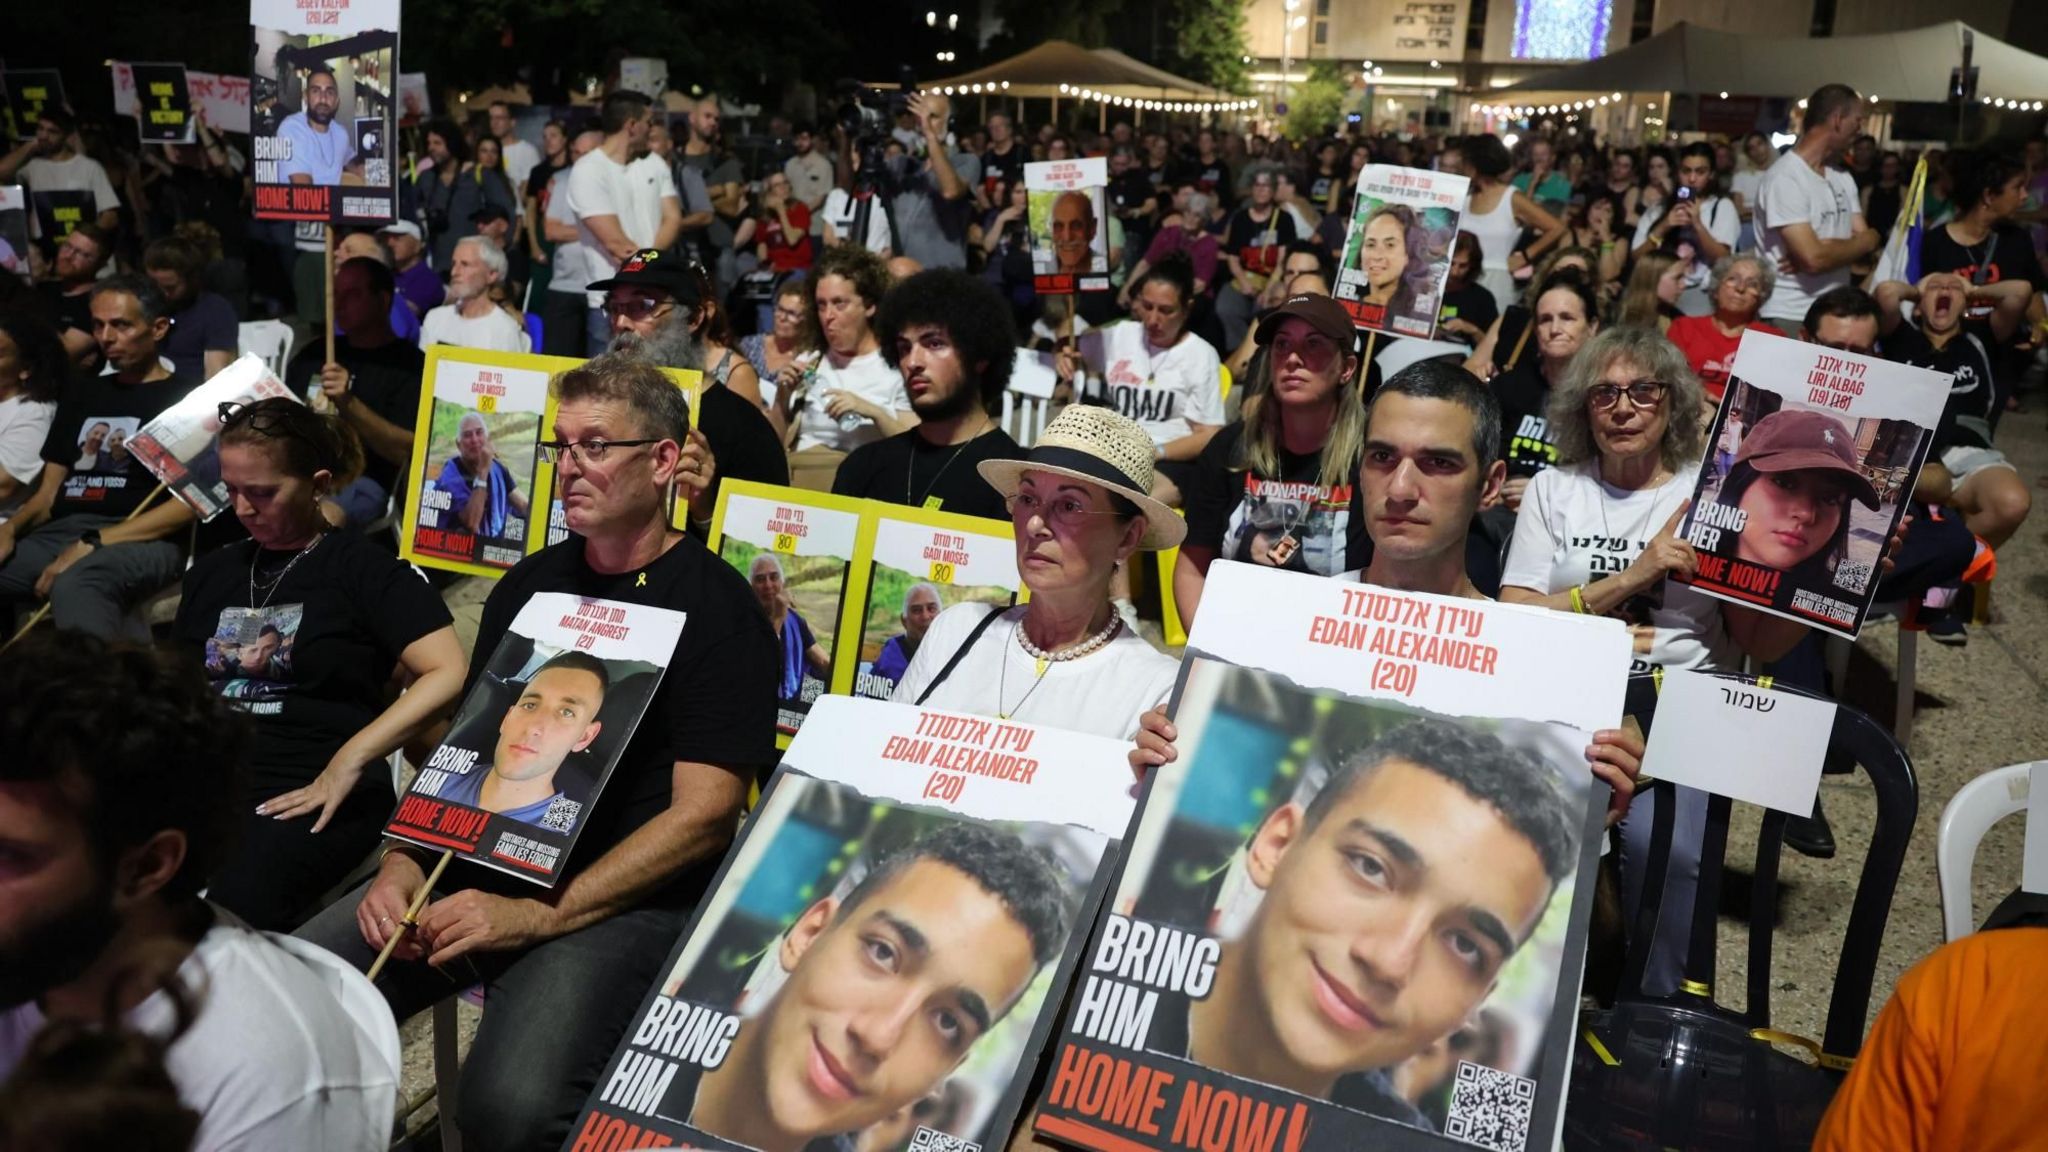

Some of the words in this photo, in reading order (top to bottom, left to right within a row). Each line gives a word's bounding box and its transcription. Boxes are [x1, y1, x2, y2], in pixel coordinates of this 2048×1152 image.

[254, 136, 293, 160] BRING
[255, 160, 278, 184] HIM
[256, 187, 290, 209] HOME
[293, 187, 330, 212] NOW!
[1807, 370, 1828, 388] LIRI
[1828, 375, 1865, 396] ALBAG
[1845, 361, 1867, 379] לירי
[481, 396, 495, 411] 80
[1808, 387, 1829, 408] (19)
[422, 489, 452, 511] BRING
[419, 507, 439, 528] HIM
[767, 519, 785, 533] GADI
[784, 522, 808, 538] MOSES
[1692, 498, 1748, 533] BRING
[416, 527, 444, 549] HOME
[445, 533, 475, 555] NOW!
[777, 534, 793, 549] 80
[1686, 523, 1721, 552] HER
[923, 546, 942, 560] GADI
[942, 549, 969, 566] MOSES
[934, 563, 951, 582] 80
[1695, 552, 1728, 581] OME
[1727, 562, 1782, 597] NOW!
[1342, 589, 1432, 629] אלכסנדר
[1791, 595, 1828, 616] FAMILIES
[1826, 606, 1856, 626] FORUM
[1794, 588, 1823, 603] HOSTAGES
[1822, 597, 1835, 607] AND
[1833, 600, 1859, 615] MISSING
[559, 615, 591, 632] MATAN
[588, 621, 631, 641] ANGREST
[1435, 605, 1484, 638] עידן
[575, 633, 597, 651] (21)
[1308, 616, 1368, 651] EDAN
[1369, 627, 1499, 676] ALEXANDER
[855, 671, 894, 699] BRING
[1371, 658, 1418, 697] (20)
[252, 702, 283, 714] HOME
[1720, 688, 1776, 713] שמור
[915, 712, 992, 745] אלכסנדר
[989, 724, 1035, 752] עידן
[427, 743, 479, 775] BRING
[881, 735, 934, 764] EDAN
[929, 743, 1039, 784] ALEXANDER
[411, 768, 450, 797] HIM
[922, 771, 967, 804] (20)
[396, 795, 444, 829] HOME
[436, 806, 491, 843] NOW!
[493, 840, 530, 861] FAMILIES
[527, 850, 557, 871] FORUM
[500, 831, 528, 847] HOSTAGES
[525, 839, 538, 851] AND
[536, 842, 561, 858] MISSING
[1092, 913, 1221, 997] BRING
[1071, 975, 1159, 1051] HIM
[631, 995, 740, 1069] BRING
[600, 1049, 680, 1117] HIM
[1047, 1044, 1174, 1136] HOME
